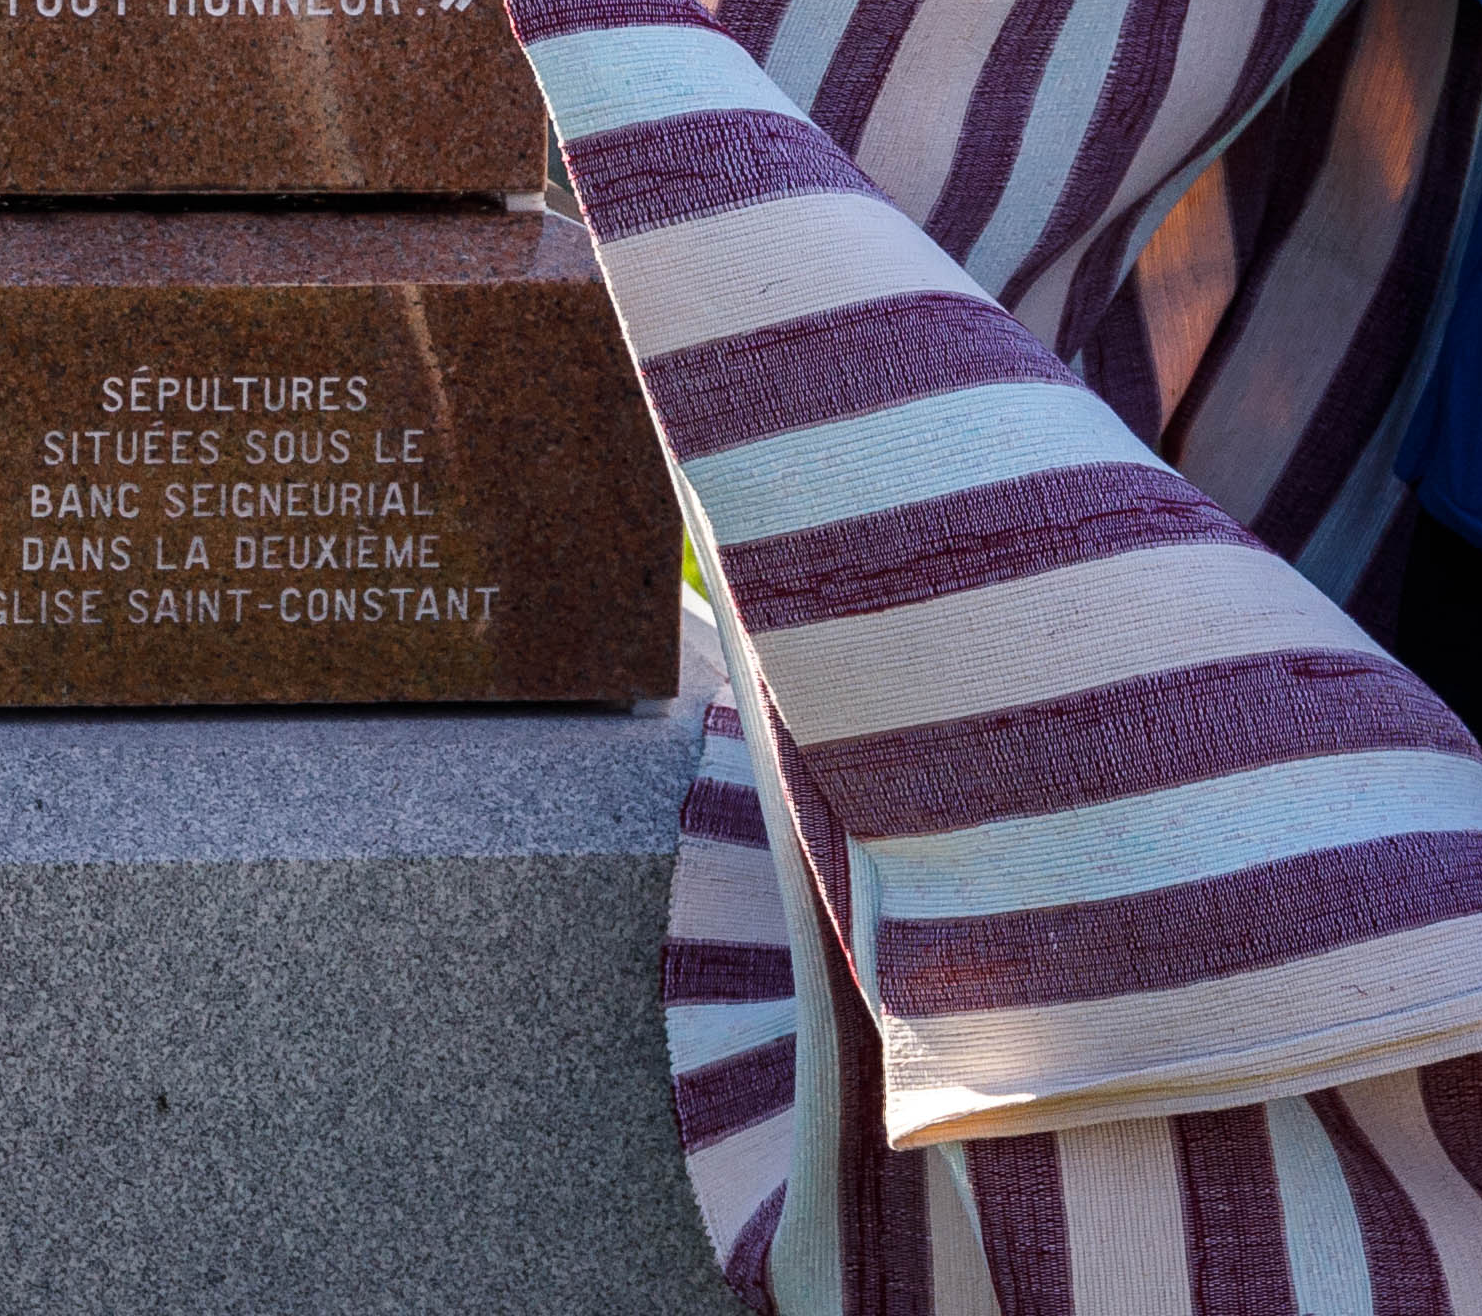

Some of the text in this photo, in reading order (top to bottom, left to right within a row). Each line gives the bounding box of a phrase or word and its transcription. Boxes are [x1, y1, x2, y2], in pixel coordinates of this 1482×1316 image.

[101, 365, 369, 414] SÉPULTURES
[43, 420, 426, 467] SITUÉES SOUS LE
[29, 482, 436, 519] BANC SEIGNEURIAL
[20, 525, 442, 572] DANS LA DEUXIÈME
[127, 586, 501, 625] SAINT-CONSTANT
